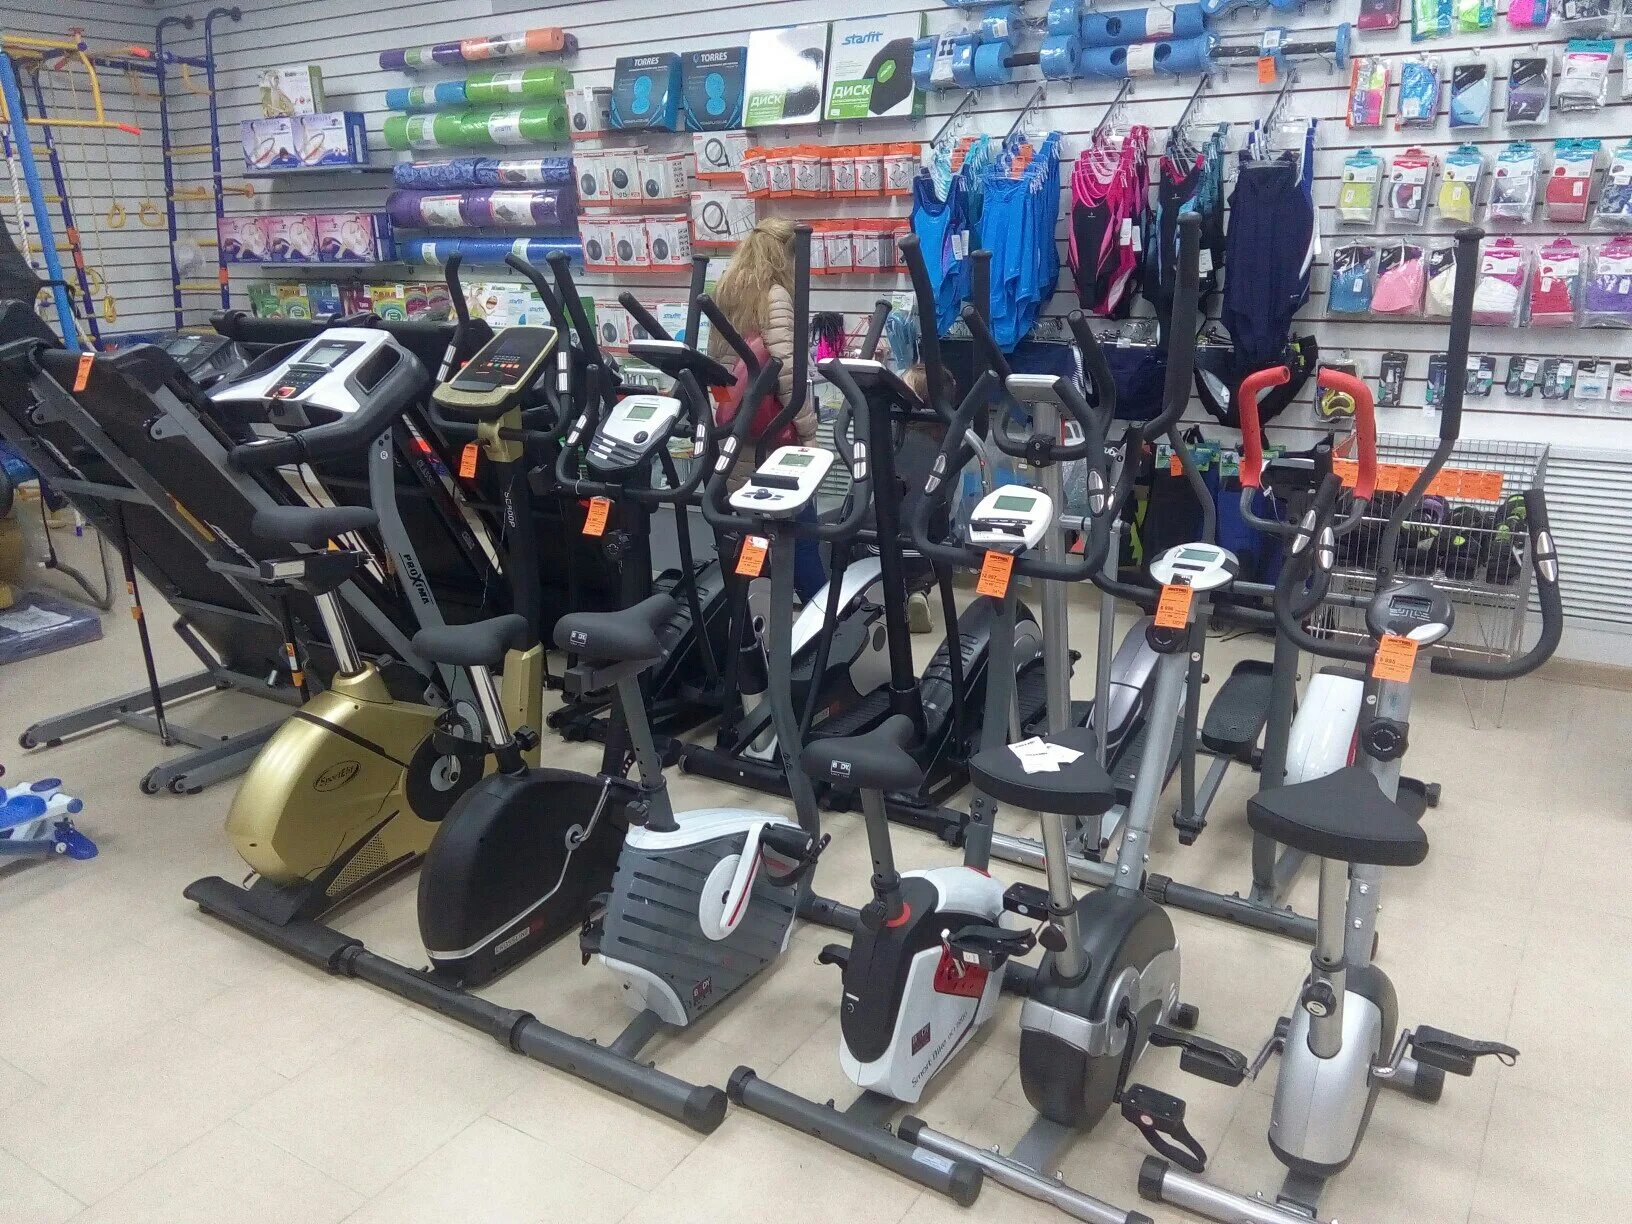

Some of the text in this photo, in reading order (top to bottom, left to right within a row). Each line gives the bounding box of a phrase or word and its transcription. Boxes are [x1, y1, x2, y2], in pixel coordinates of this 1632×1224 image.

[842, 32, 884, 45] starfit
[634, 56, 660, 66] TORRES
[701, 52, 728, 62] TORRES
[833, 84, 872, 99] ДИСК
[751, 93, 781, 108] ДИСК
[403, 554, 430, 604] PROXIMA
